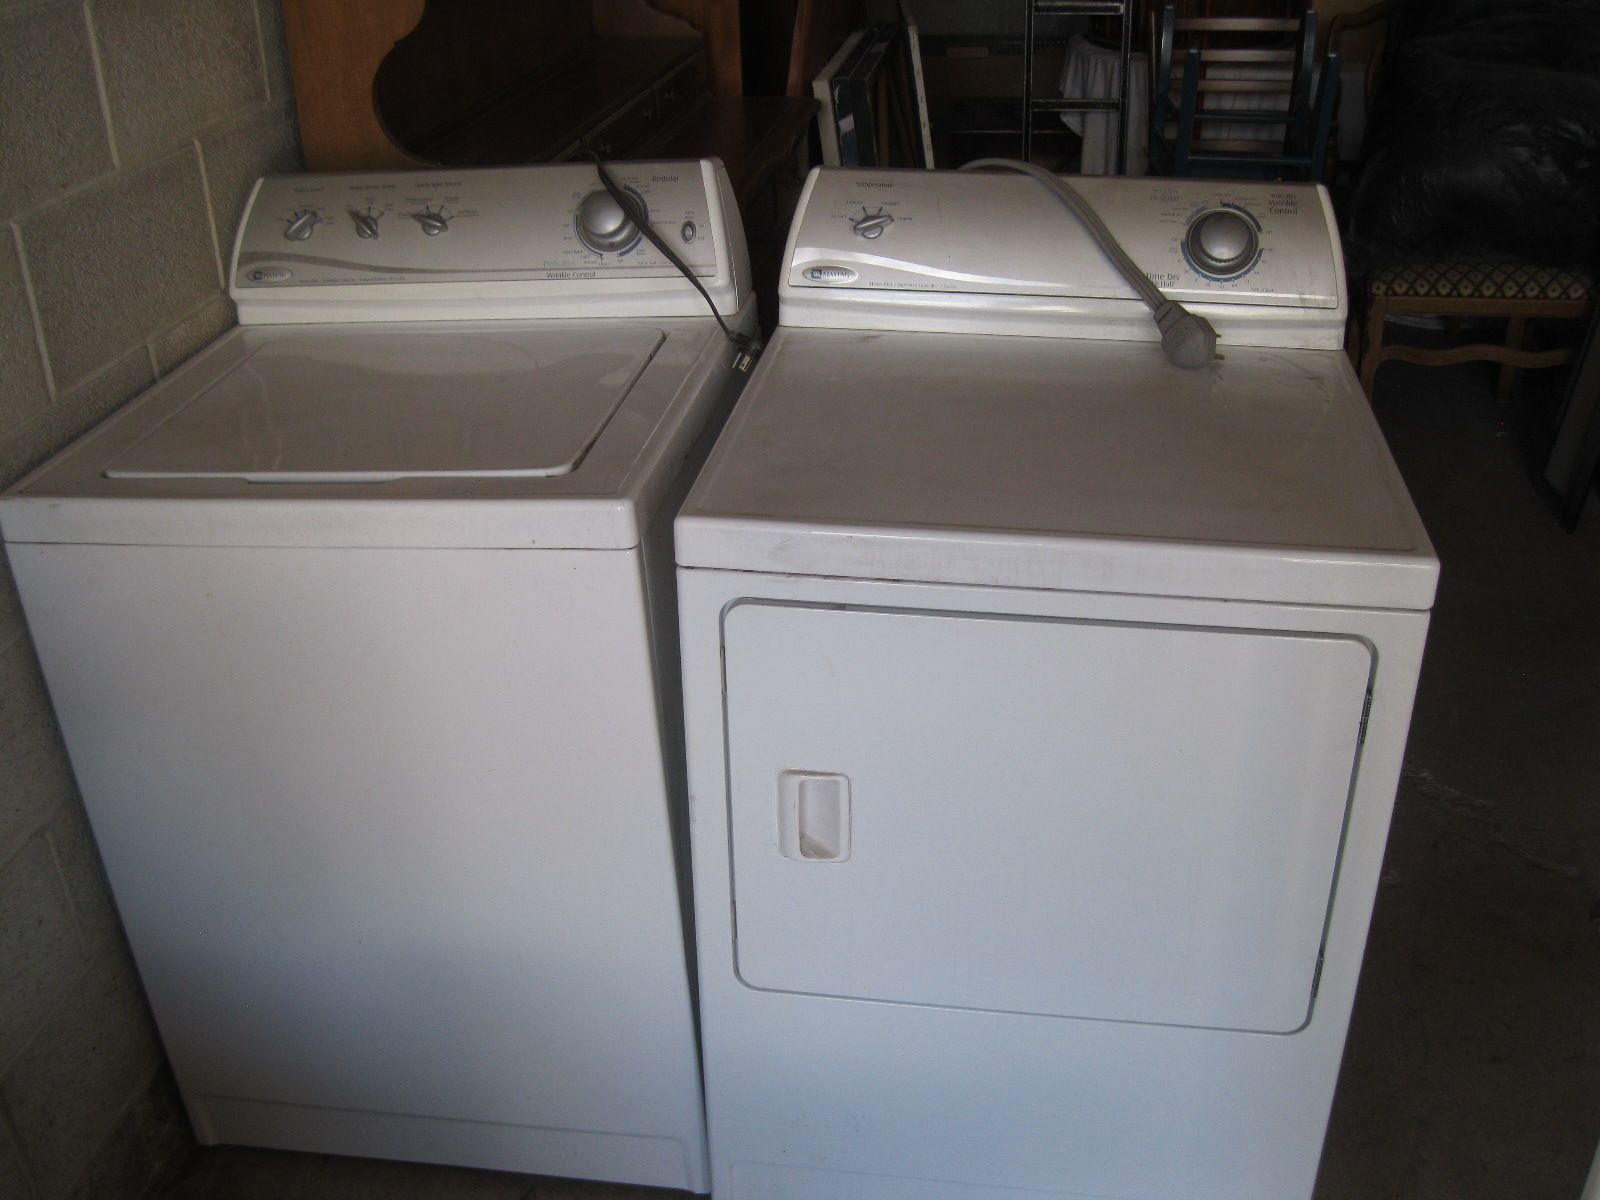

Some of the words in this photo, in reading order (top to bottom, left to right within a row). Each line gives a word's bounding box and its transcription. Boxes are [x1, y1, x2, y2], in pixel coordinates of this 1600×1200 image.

[1269, 199, 1299, 208] Wrinkle
[1269, 207, 1299, 217] Control
[546, 271, 571, 279] Wrinkle
[572, 270, 596, 279] Control
[822, 271, 851, 279] MAYTAG
[1167, 272, 1181, 282] Dry
